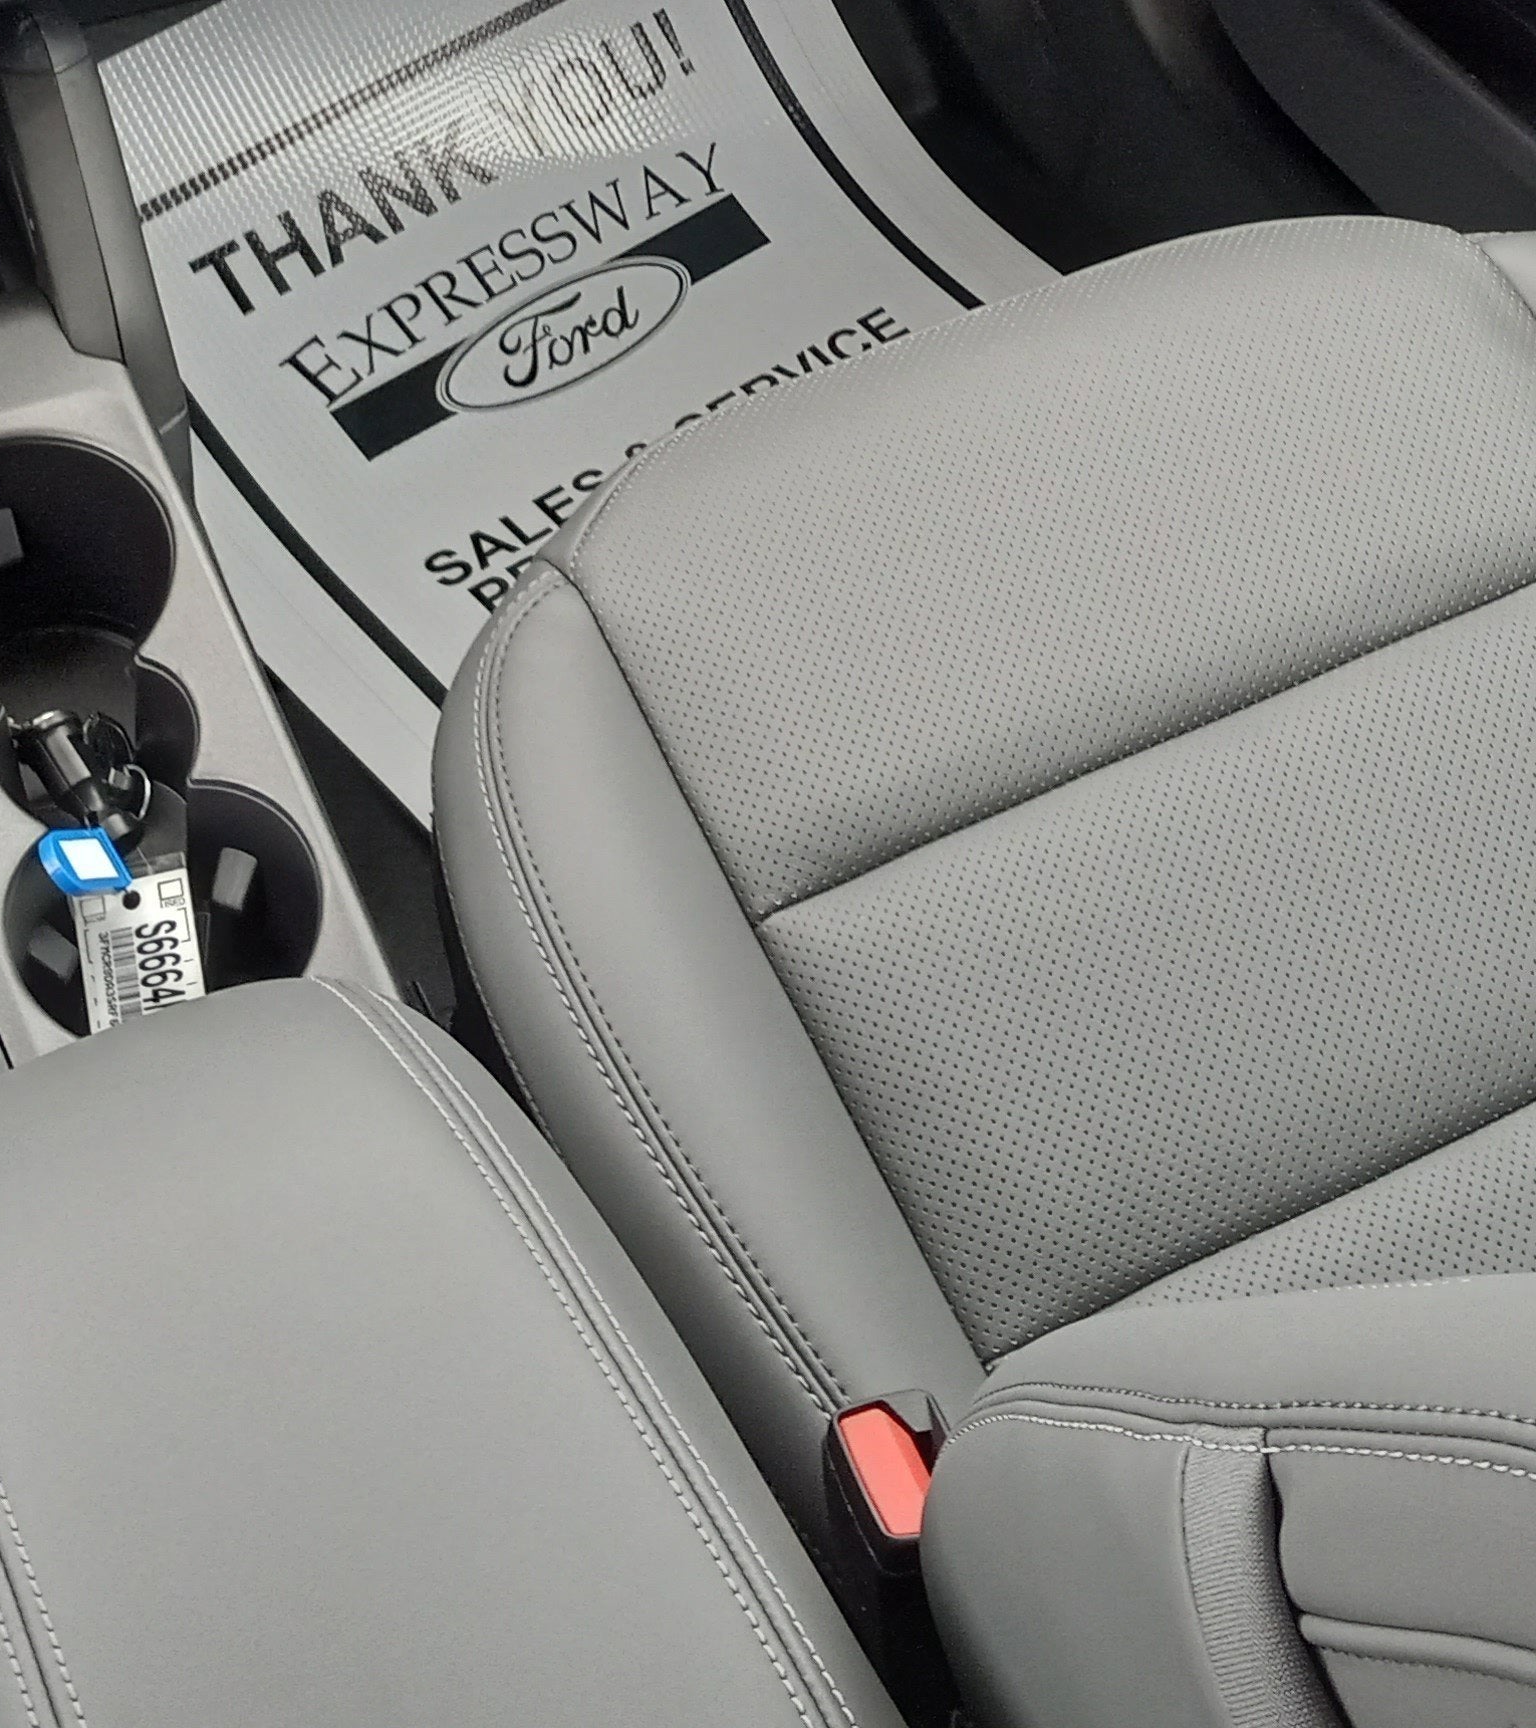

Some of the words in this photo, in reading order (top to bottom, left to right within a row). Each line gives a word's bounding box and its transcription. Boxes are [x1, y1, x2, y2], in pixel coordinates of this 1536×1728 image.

[189, 118, 500, 317] THANK
[279, 142, 725, 408] EXPRESSWAY
[498, 285, 641, 388] Ford
